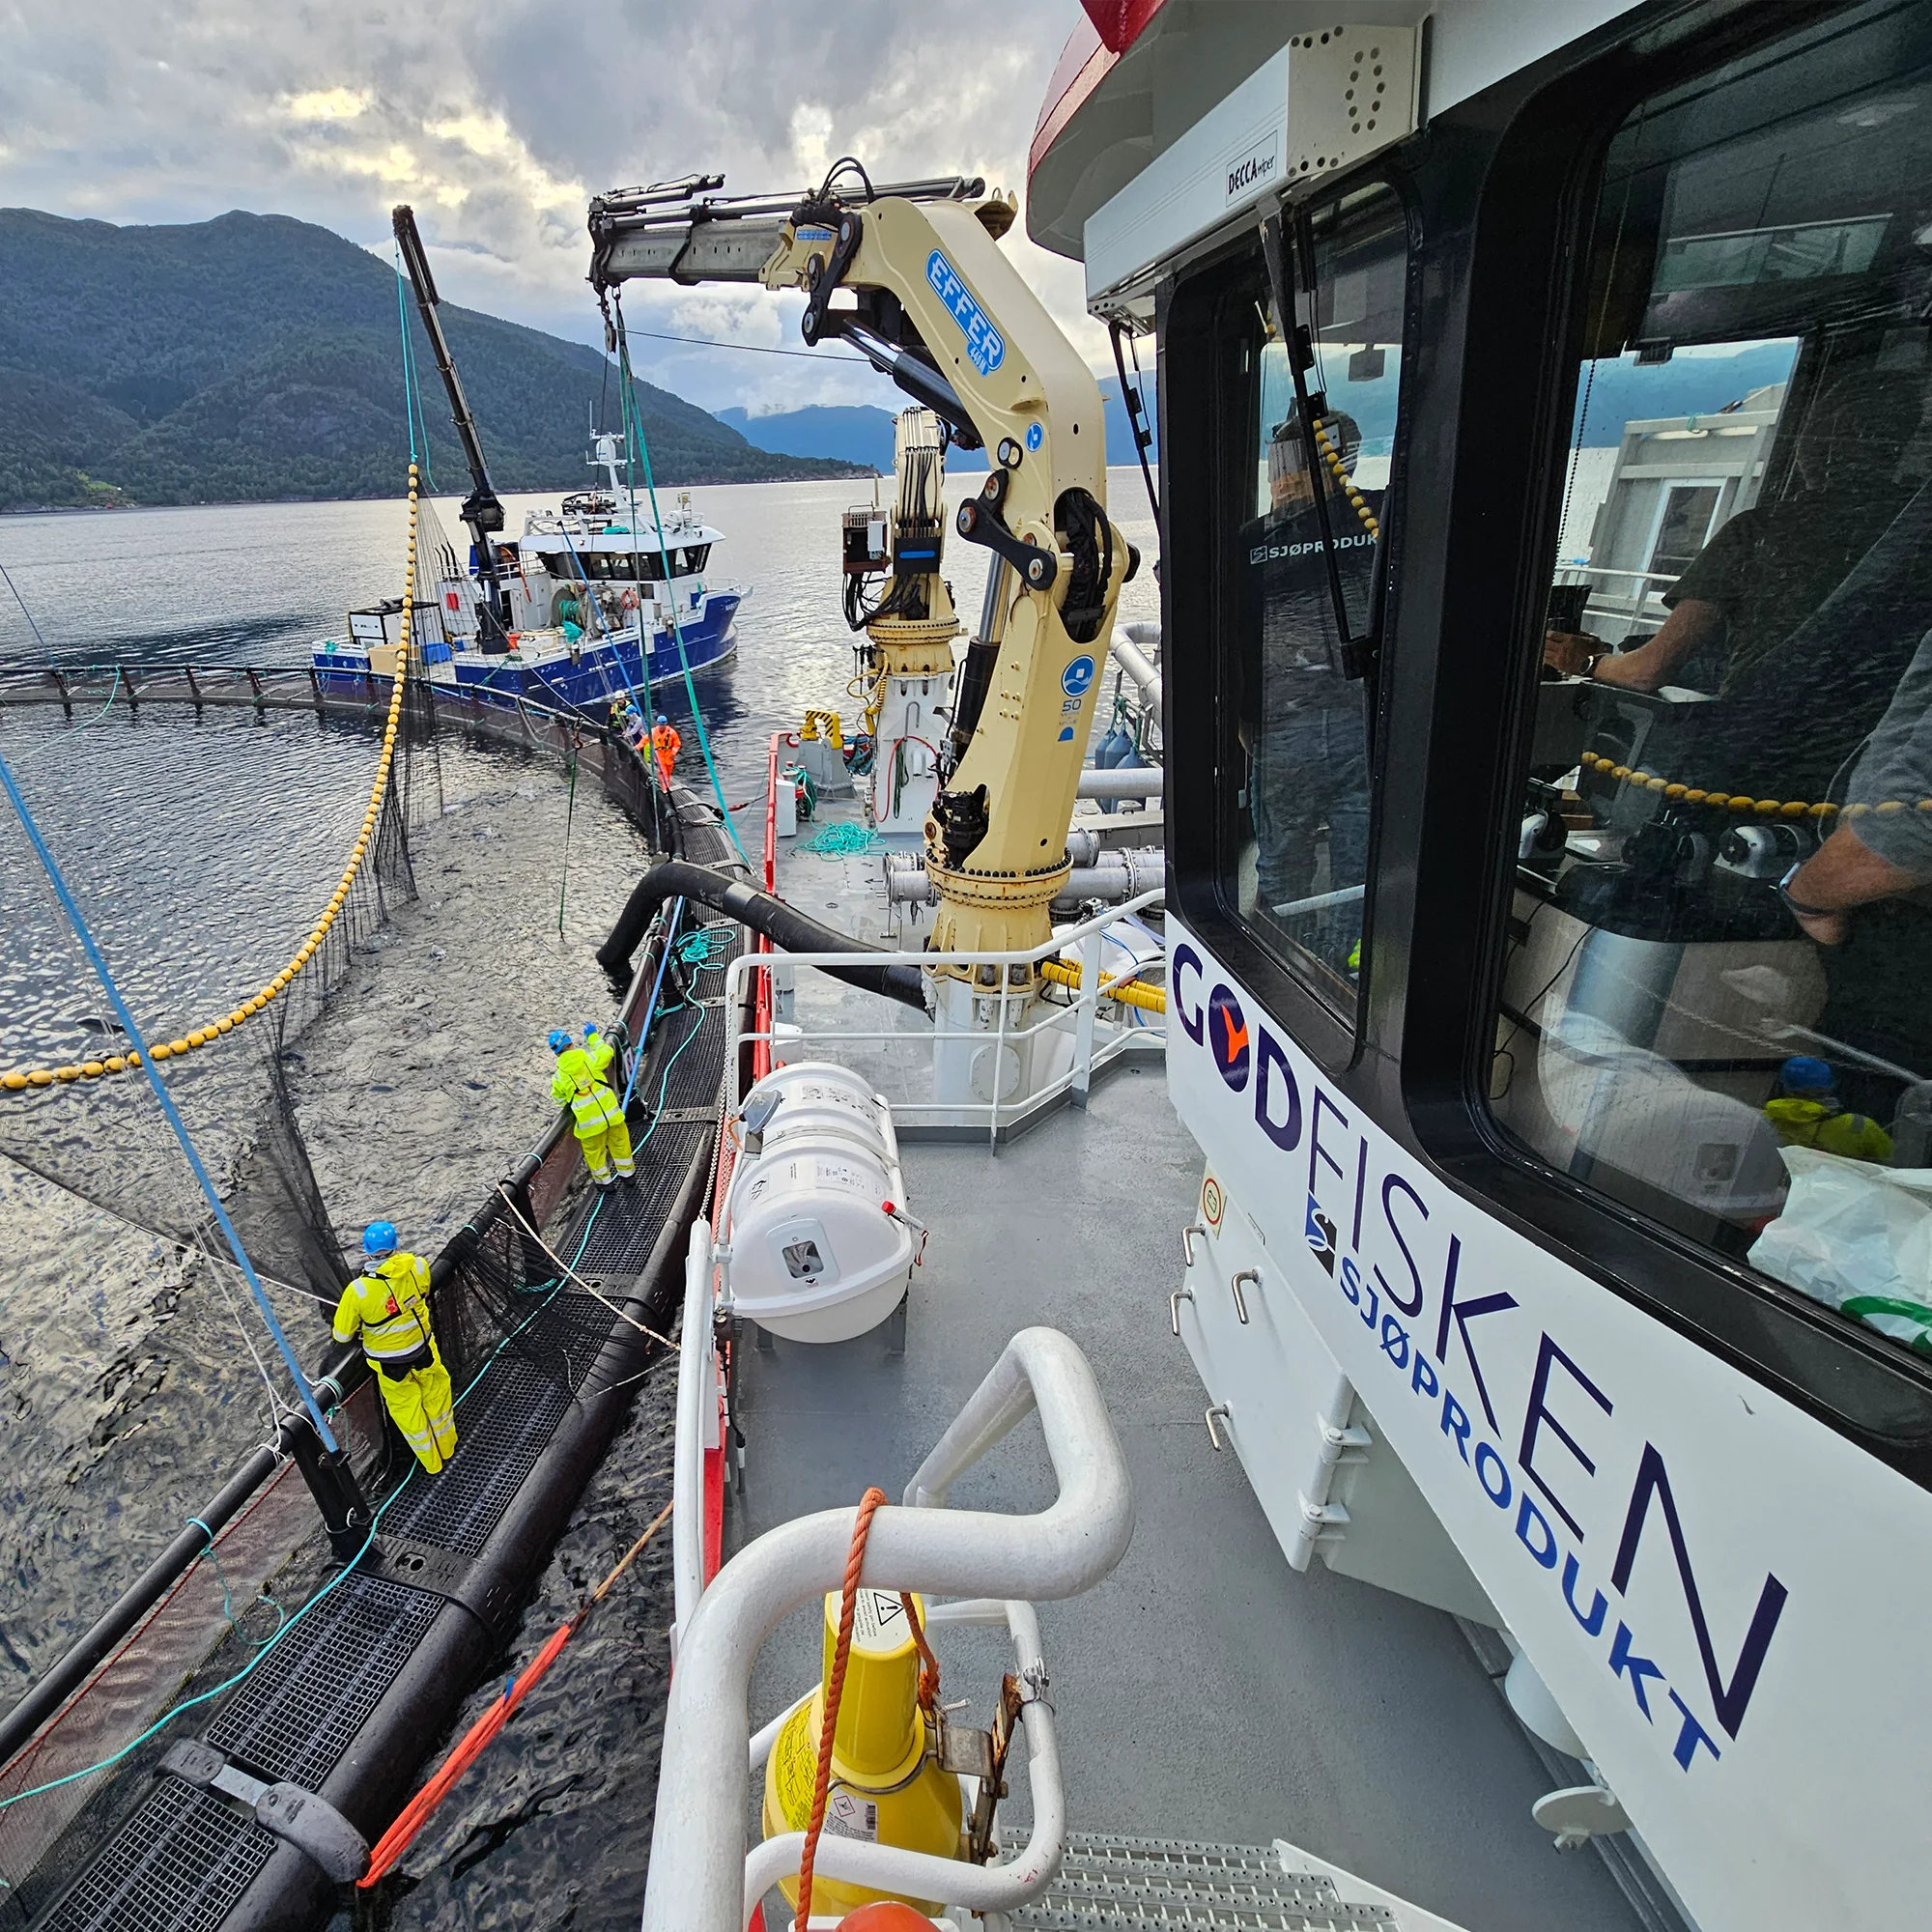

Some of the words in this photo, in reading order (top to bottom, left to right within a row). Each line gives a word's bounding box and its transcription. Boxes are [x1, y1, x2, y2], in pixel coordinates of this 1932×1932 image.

[930, 256, 1002, 366] EFFER
[1062, 698, 1082, 713] 50
[1172, 943, 1788, 1743] GODFISKEN
[1339, 1255, 1721, 1774] SJØPRODUKT
